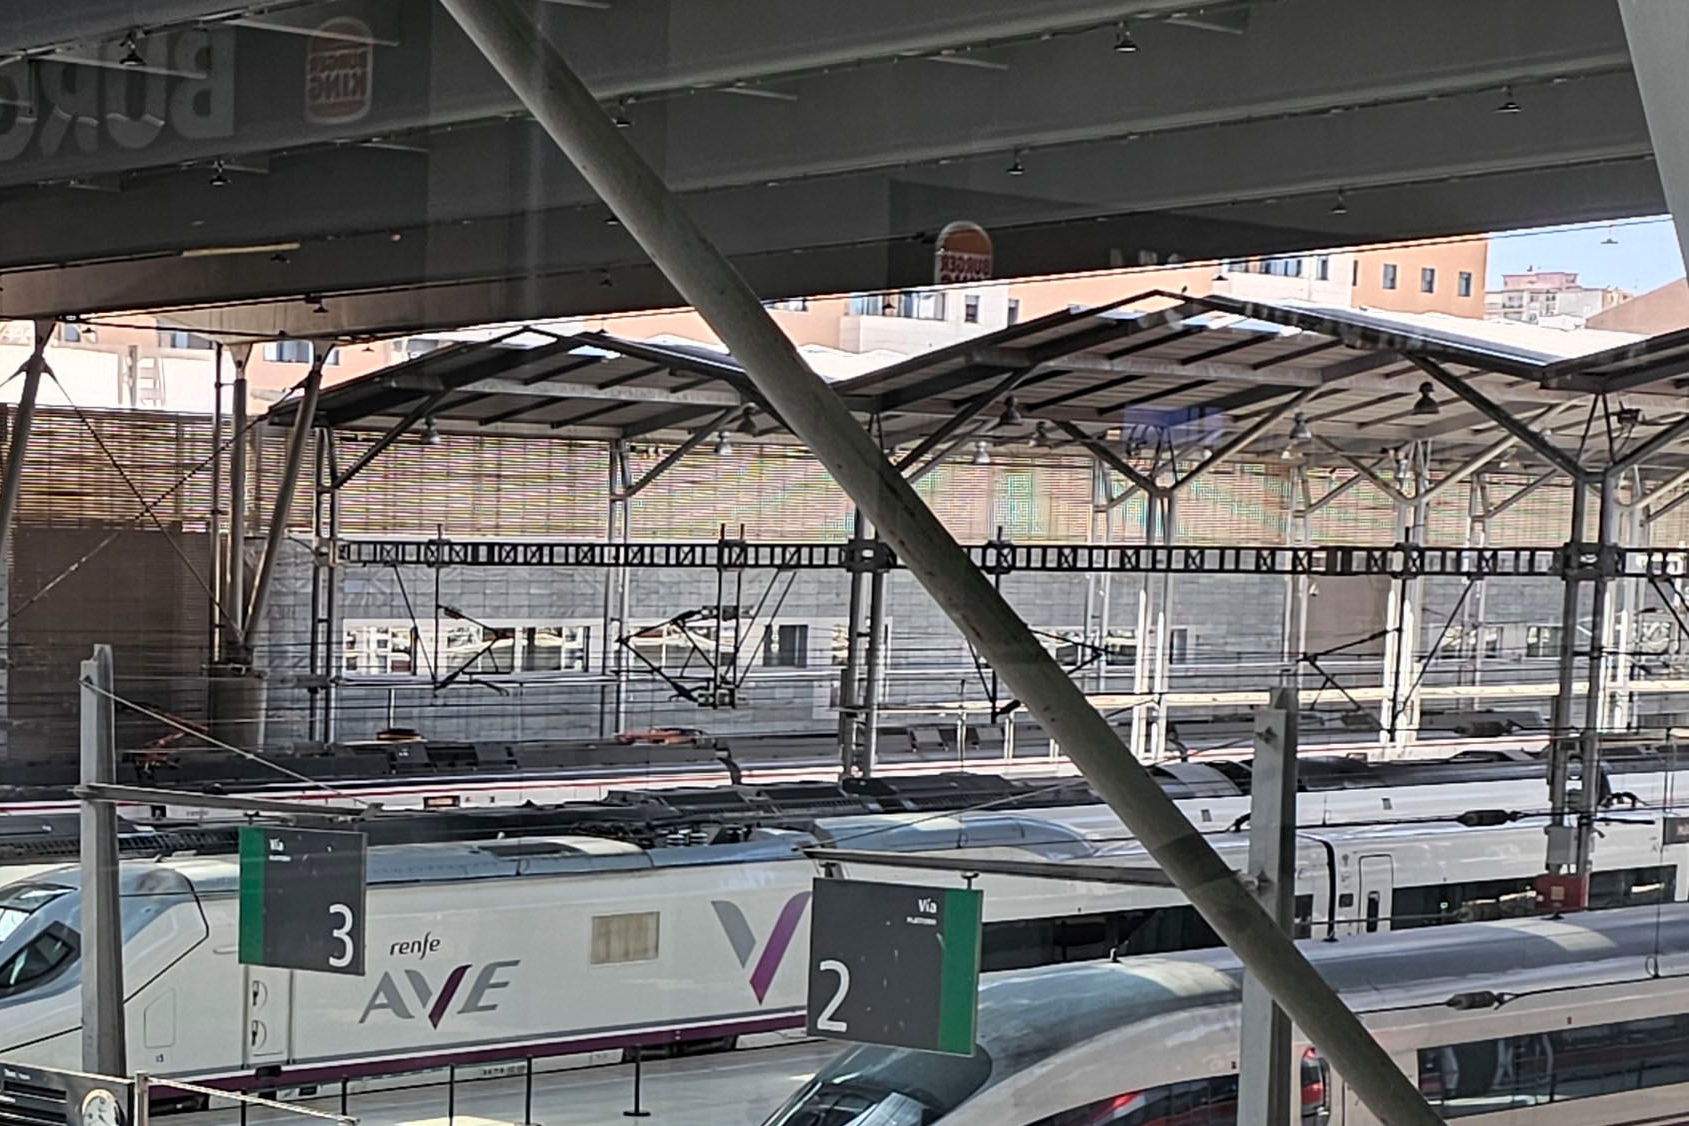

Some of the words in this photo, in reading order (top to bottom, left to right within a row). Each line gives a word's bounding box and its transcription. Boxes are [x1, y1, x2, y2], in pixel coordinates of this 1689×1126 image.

[328, 903, 355, 967] 3
[389, 931, 441, 960] renfe
[358, 959, 522, 1031] AVE
[816, 959, 851, 1033] 2
